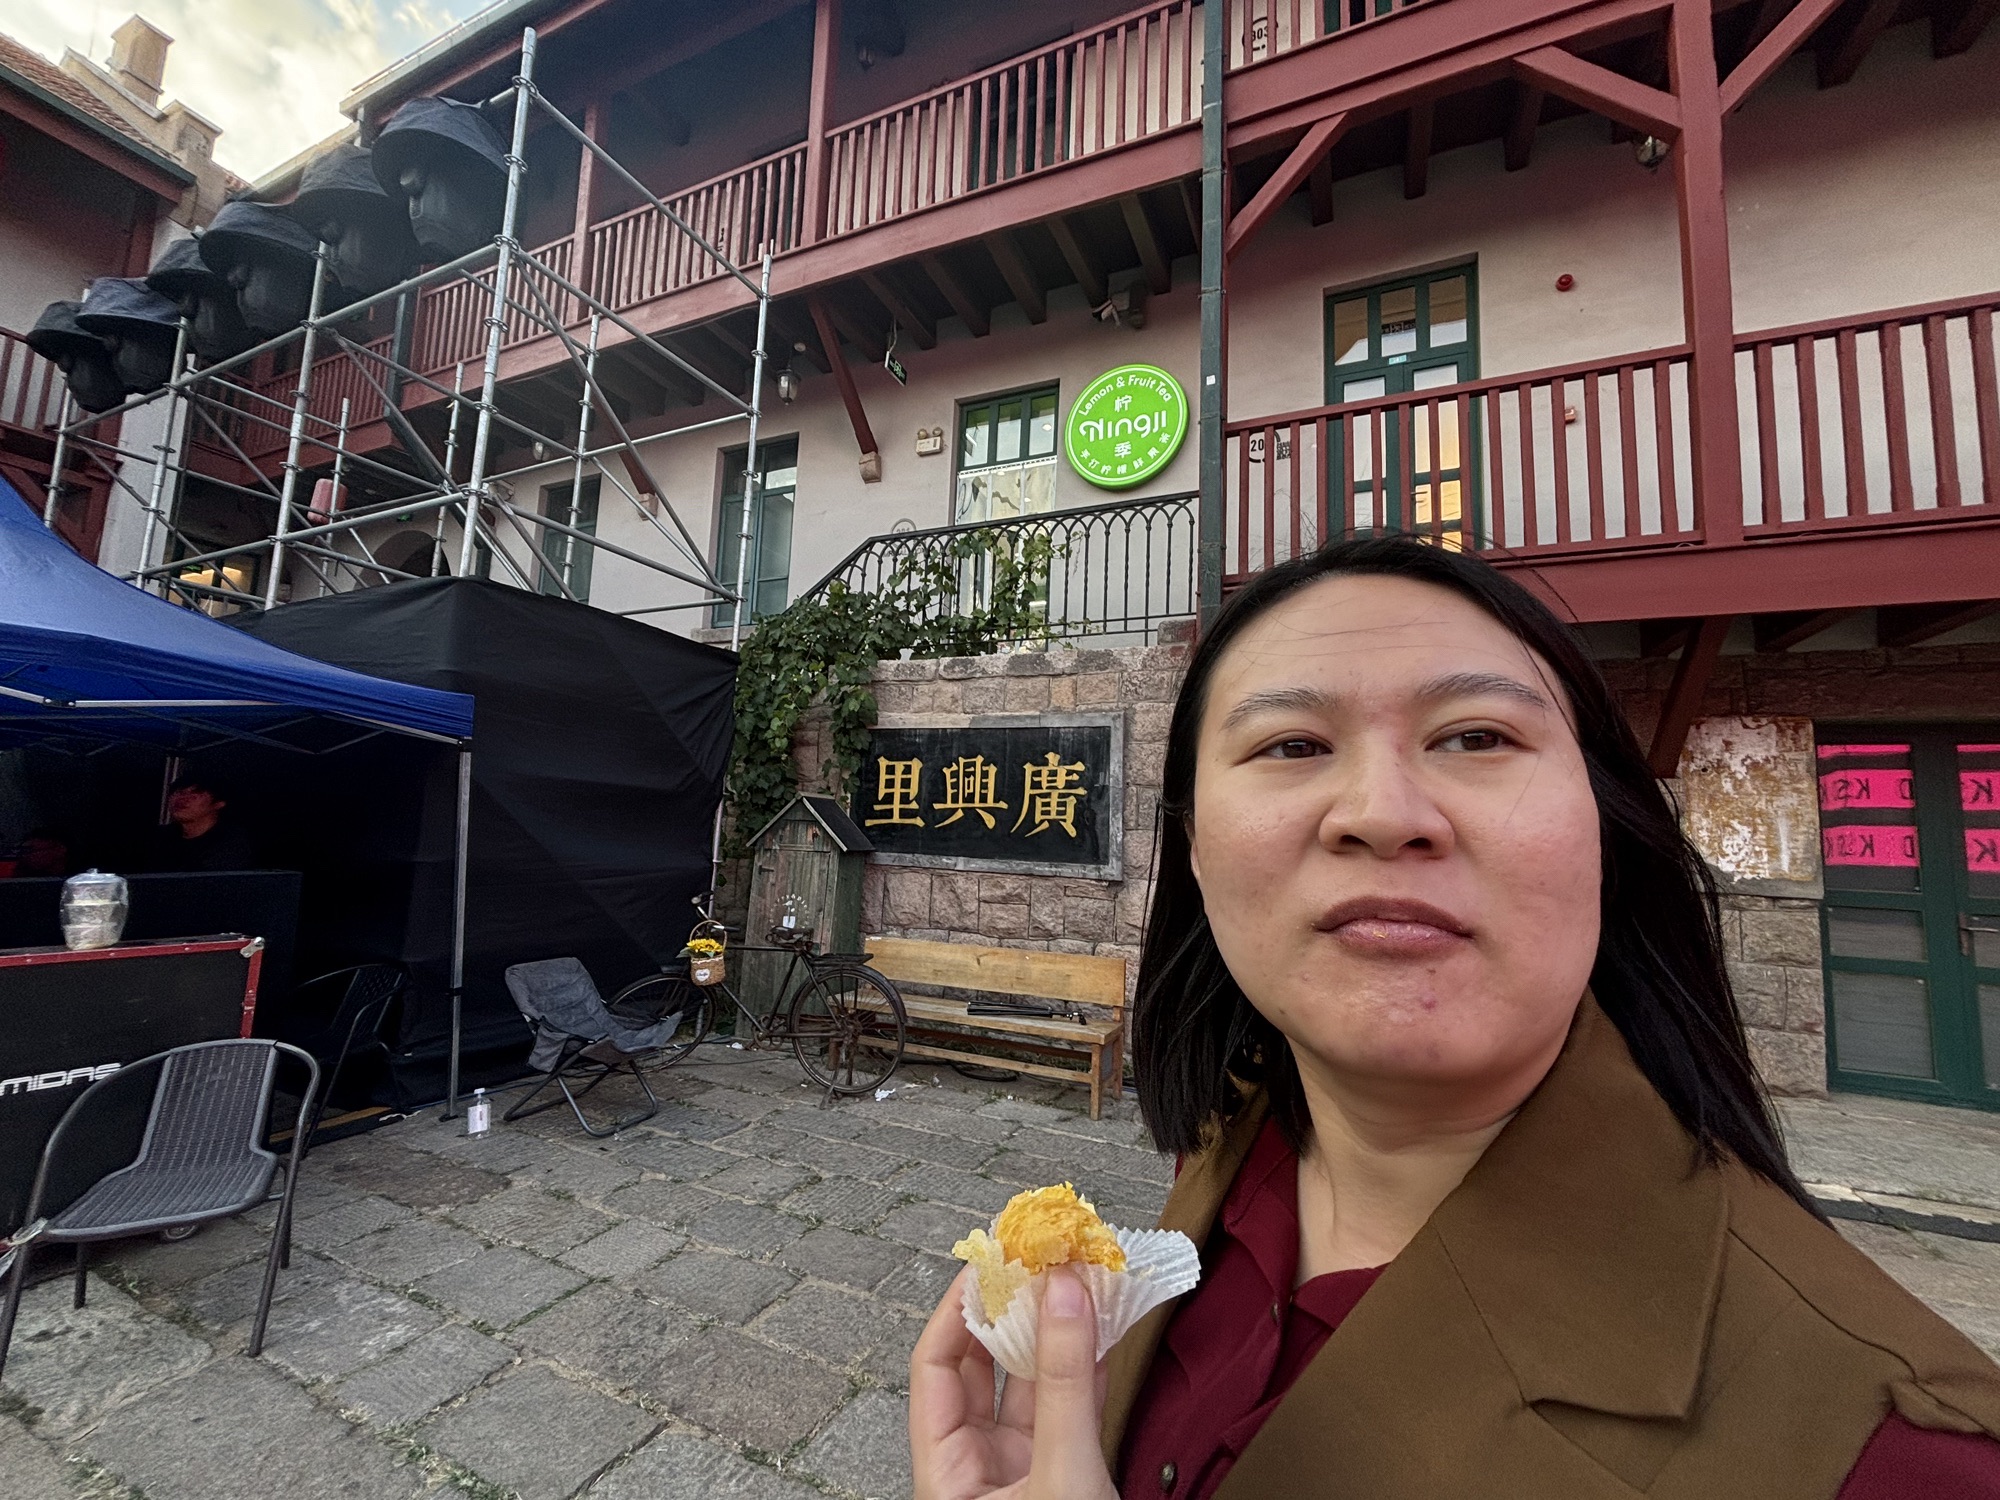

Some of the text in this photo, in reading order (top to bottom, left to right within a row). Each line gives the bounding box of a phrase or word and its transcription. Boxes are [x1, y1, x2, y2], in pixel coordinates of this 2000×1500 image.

[1078, 374, 1173, 416] Lemon & Fruit Tea
[1114, 394, 1132, 412] 柠
[1114, 441, 1132, 459] 季
